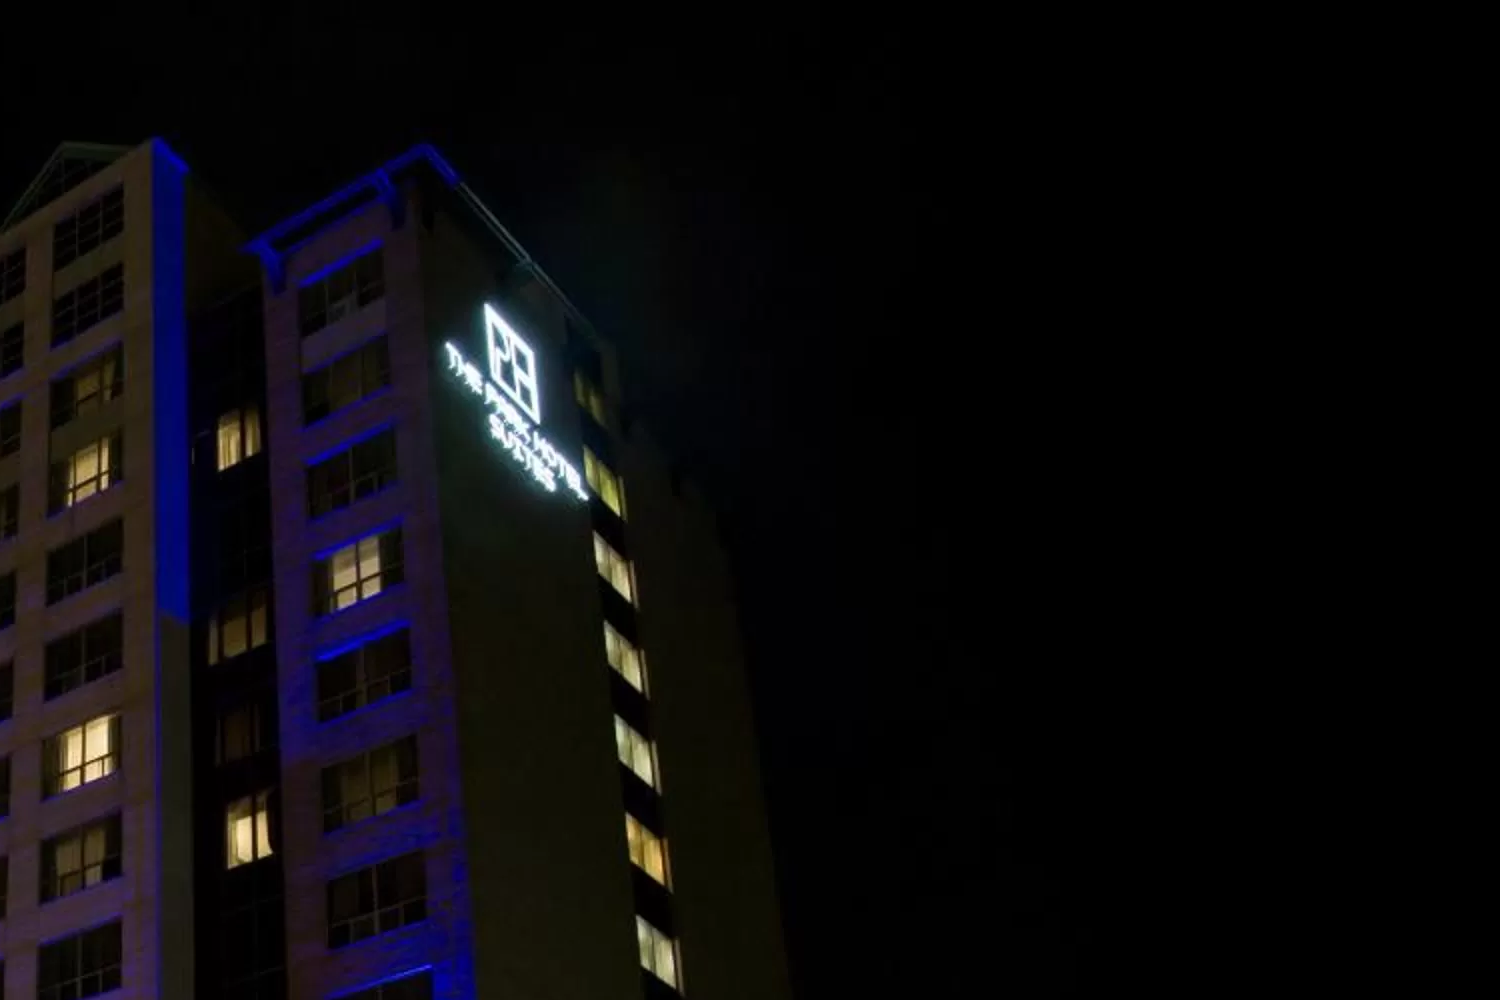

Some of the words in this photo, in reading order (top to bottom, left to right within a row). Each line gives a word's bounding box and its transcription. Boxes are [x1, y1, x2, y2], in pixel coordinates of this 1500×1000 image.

[445, 341, 483, 396] THE
[484, 382, 531, 445] PARK
[533, 431, 589, 501] HOTEL
[489, 413, 556, 492] SUITES
